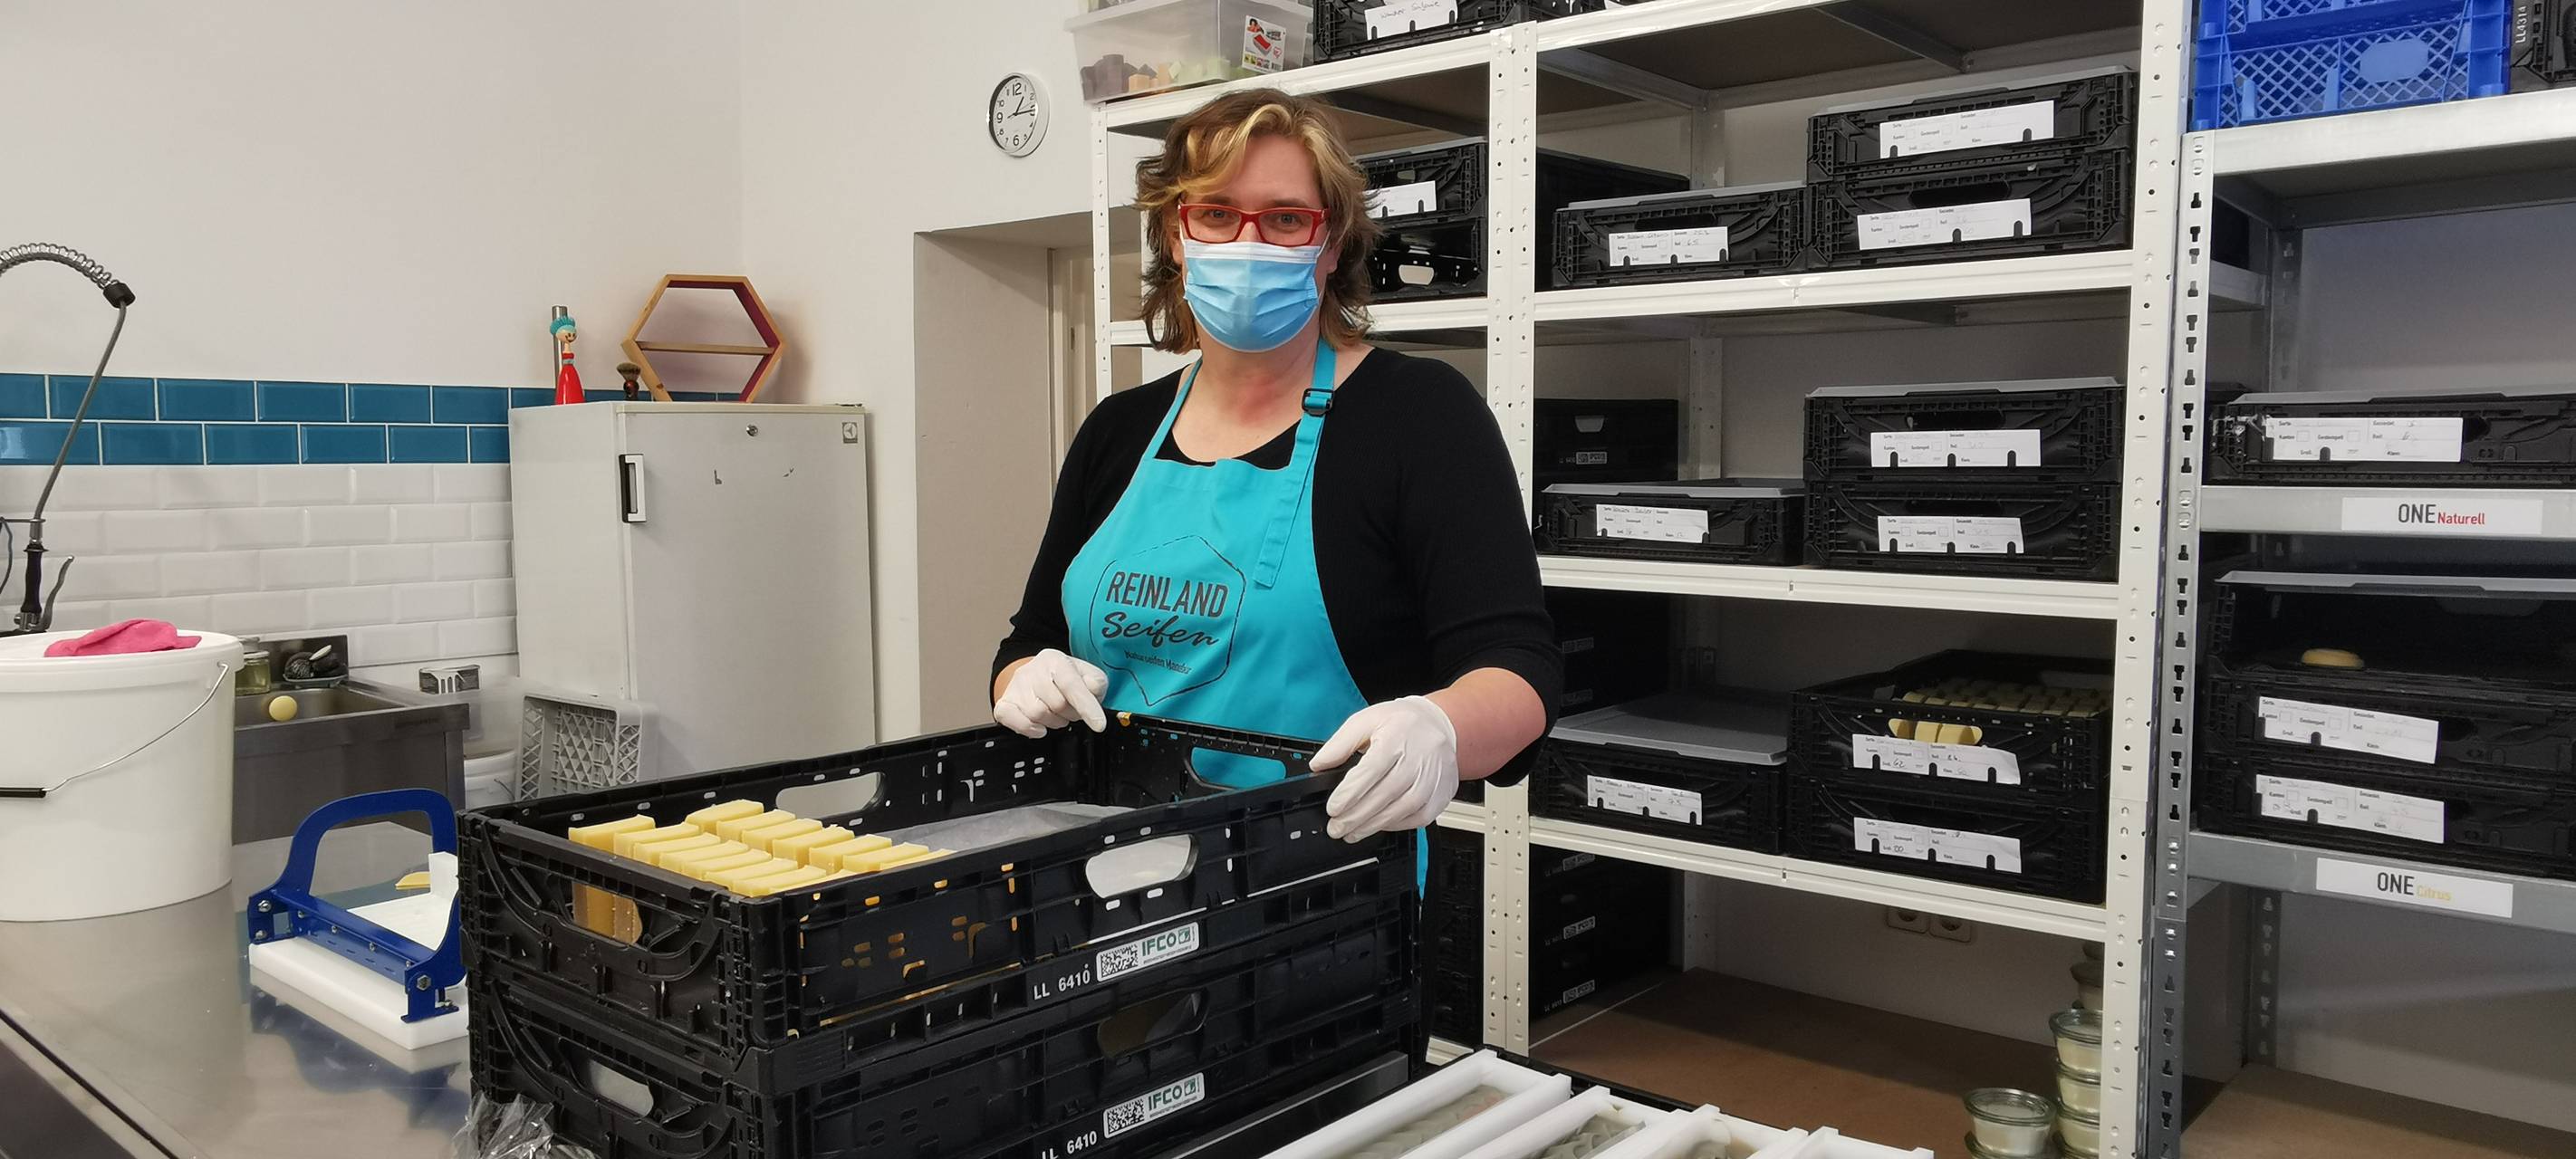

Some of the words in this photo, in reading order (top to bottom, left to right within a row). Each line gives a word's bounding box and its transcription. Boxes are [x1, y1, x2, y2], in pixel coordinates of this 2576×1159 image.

[2515, 5, 2528, 43] LL4314
[1013, 82, 1022, 96] 12
[996, 112, 1003, 123] 9
[1013, 134, 1020, 146] 6
[2398, 503, 2437, 523] ONE
[2437, 512, 2485, 525] Naturell
[1105, 571, 1228, 618] REINLAND
[1101, 611, 1220, 648] Seifen
[2377, 872, 2415, 896] ONE
[1142, 932, 1177, 956] IFCO
[1033, 982, 1051, 1001] LL
[1058, 970, 1091, 992] 6410
[1149, 1085, 1182, 1111] IFCO
[1067, 1131, 1097, 1154] 6410
